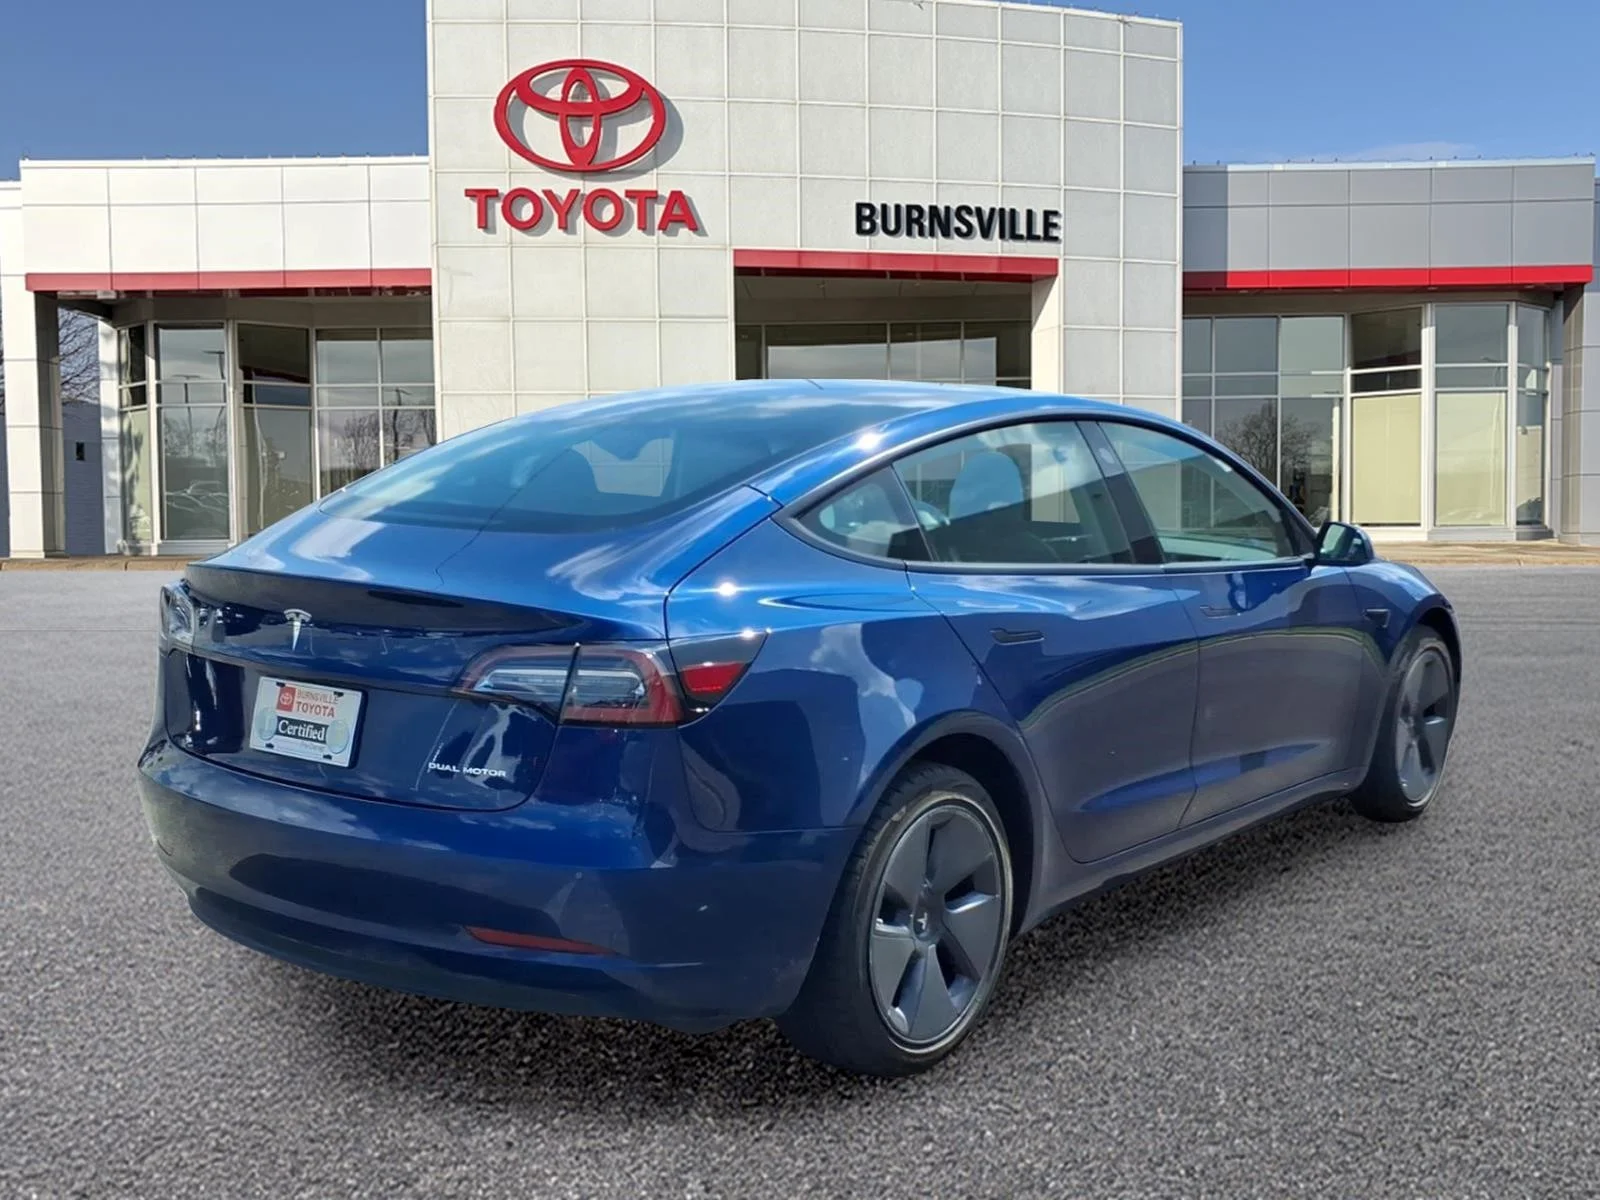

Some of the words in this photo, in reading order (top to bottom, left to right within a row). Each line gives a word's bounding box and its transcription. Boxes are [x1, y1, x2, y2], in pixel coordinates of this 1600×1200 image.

[465, 188, 699, 232] TOYOTA
[855, 201, 1061, 243] BURNSVILLE
[297, 688, 339, 705] BURNSVILLE
[296, 701, 335, 718] TOYOTA
[278, 718, 325, 741] Certified
[428, 762, 460, 774] DUAL
[462, 766, 507, 778] MOTOR
